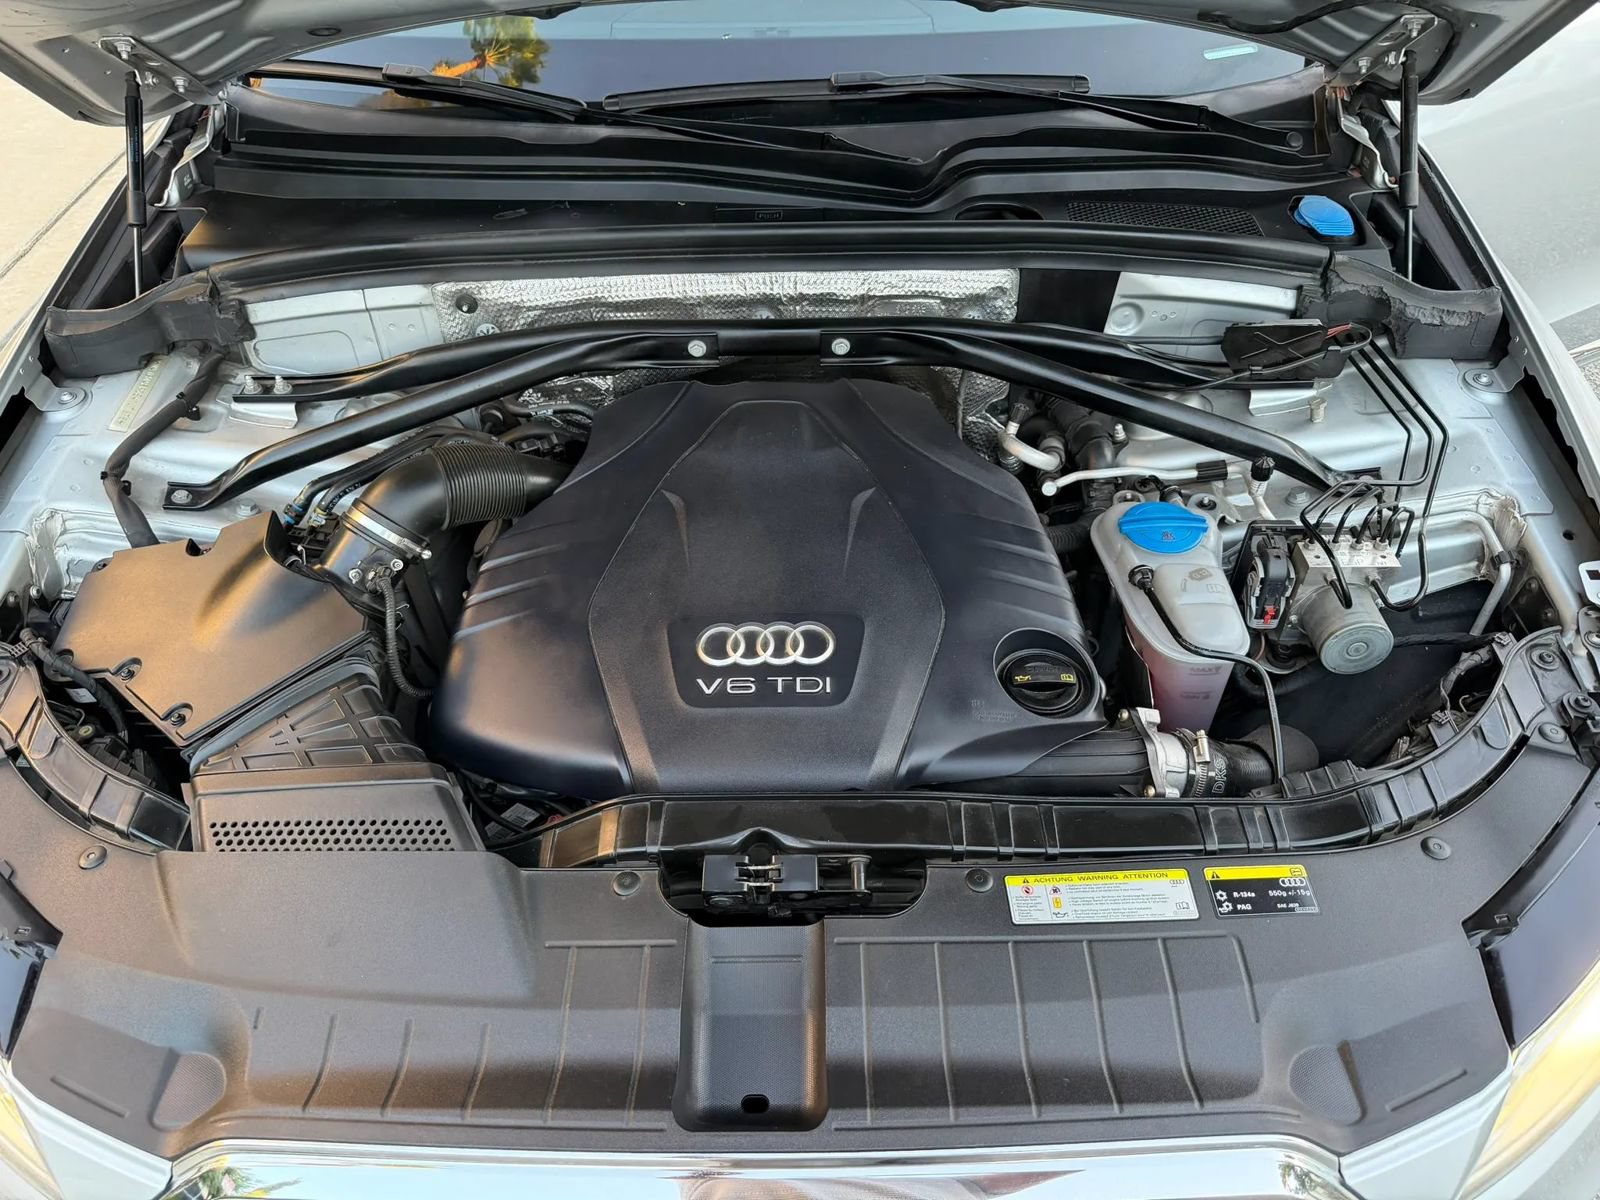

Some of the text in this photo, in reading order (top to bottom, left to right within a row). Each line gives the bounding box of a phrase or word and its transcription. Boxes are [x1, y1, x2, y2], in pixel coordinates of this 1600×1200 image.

[696, 676, 832, 695] V6 TDI
[1077, 874, 1119, 882] WARNING
[1122, 872, 1168, 880] ATTENTION
[1268, 889, 1286, 897] 550g
